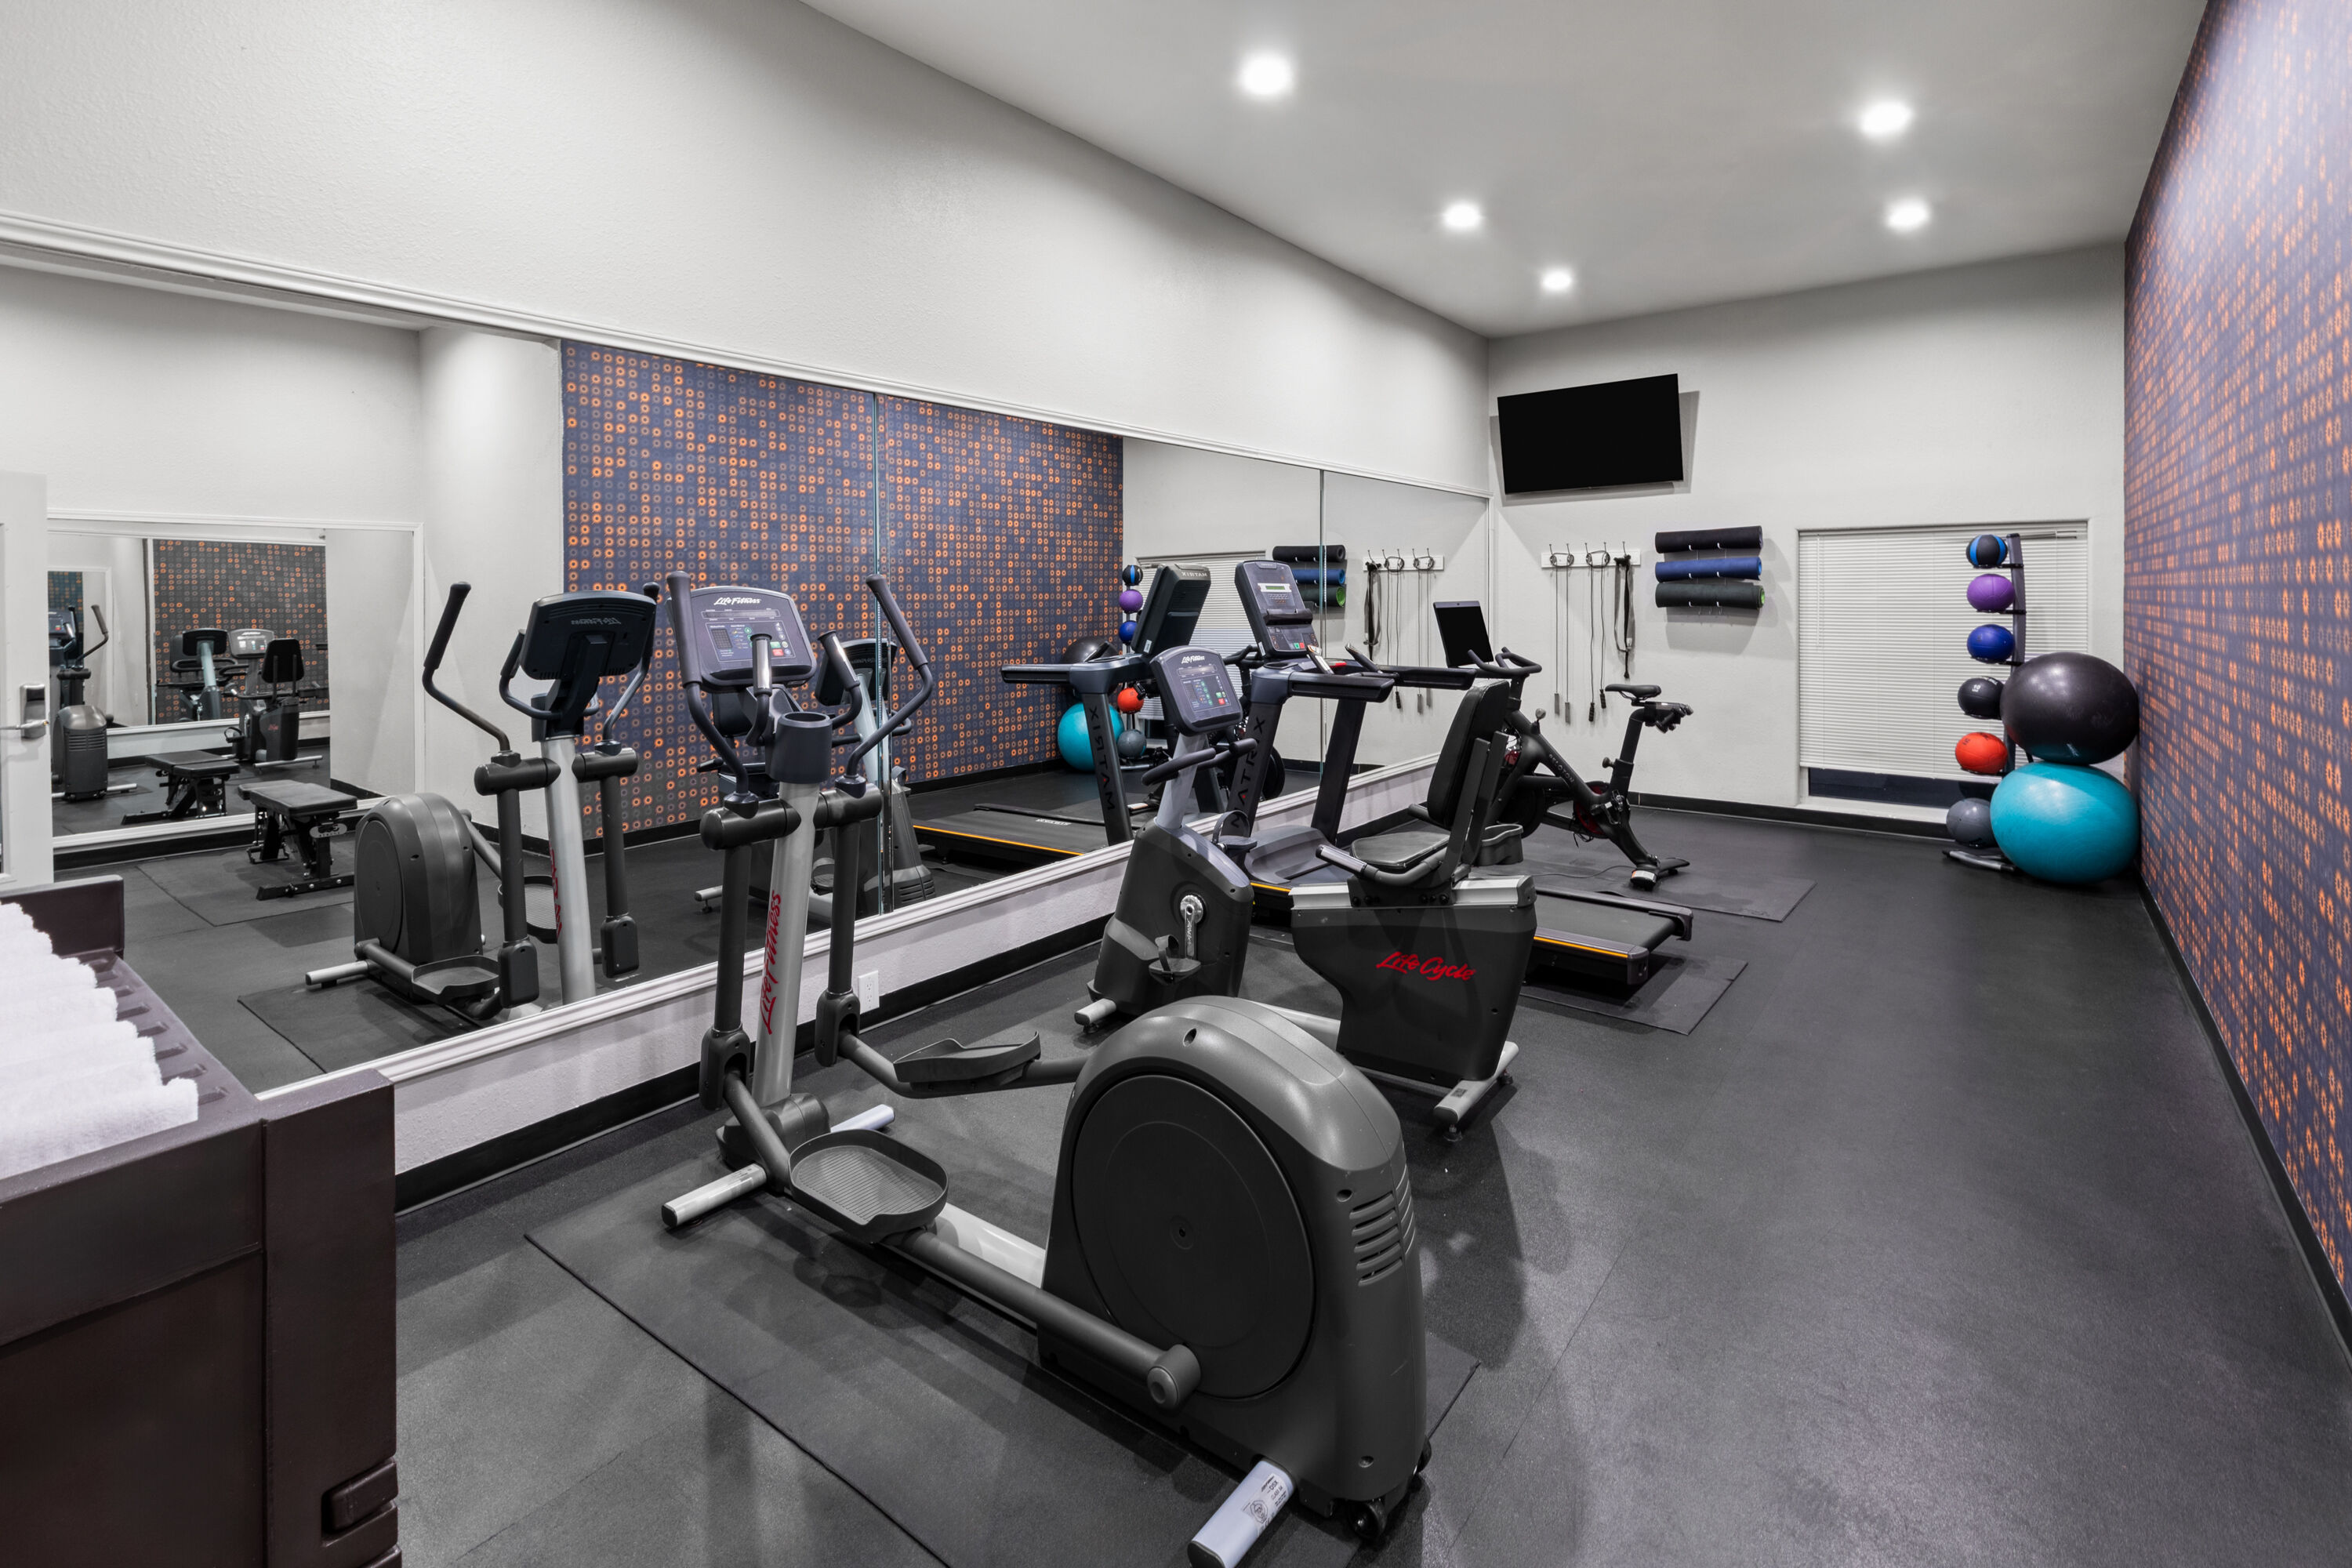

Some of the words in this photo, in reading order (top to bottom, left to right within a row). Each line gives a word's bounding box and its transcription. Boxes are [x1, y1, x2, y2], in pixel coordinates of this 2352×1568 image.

[713, 597, 731, 605] Life
[731, 597, 760, 605] Fitness
[1230, 716, 1265, 828] MATRX
[1376, 951, 1420, 975] Life
[1419, 956, 1475, 982] Cycle
